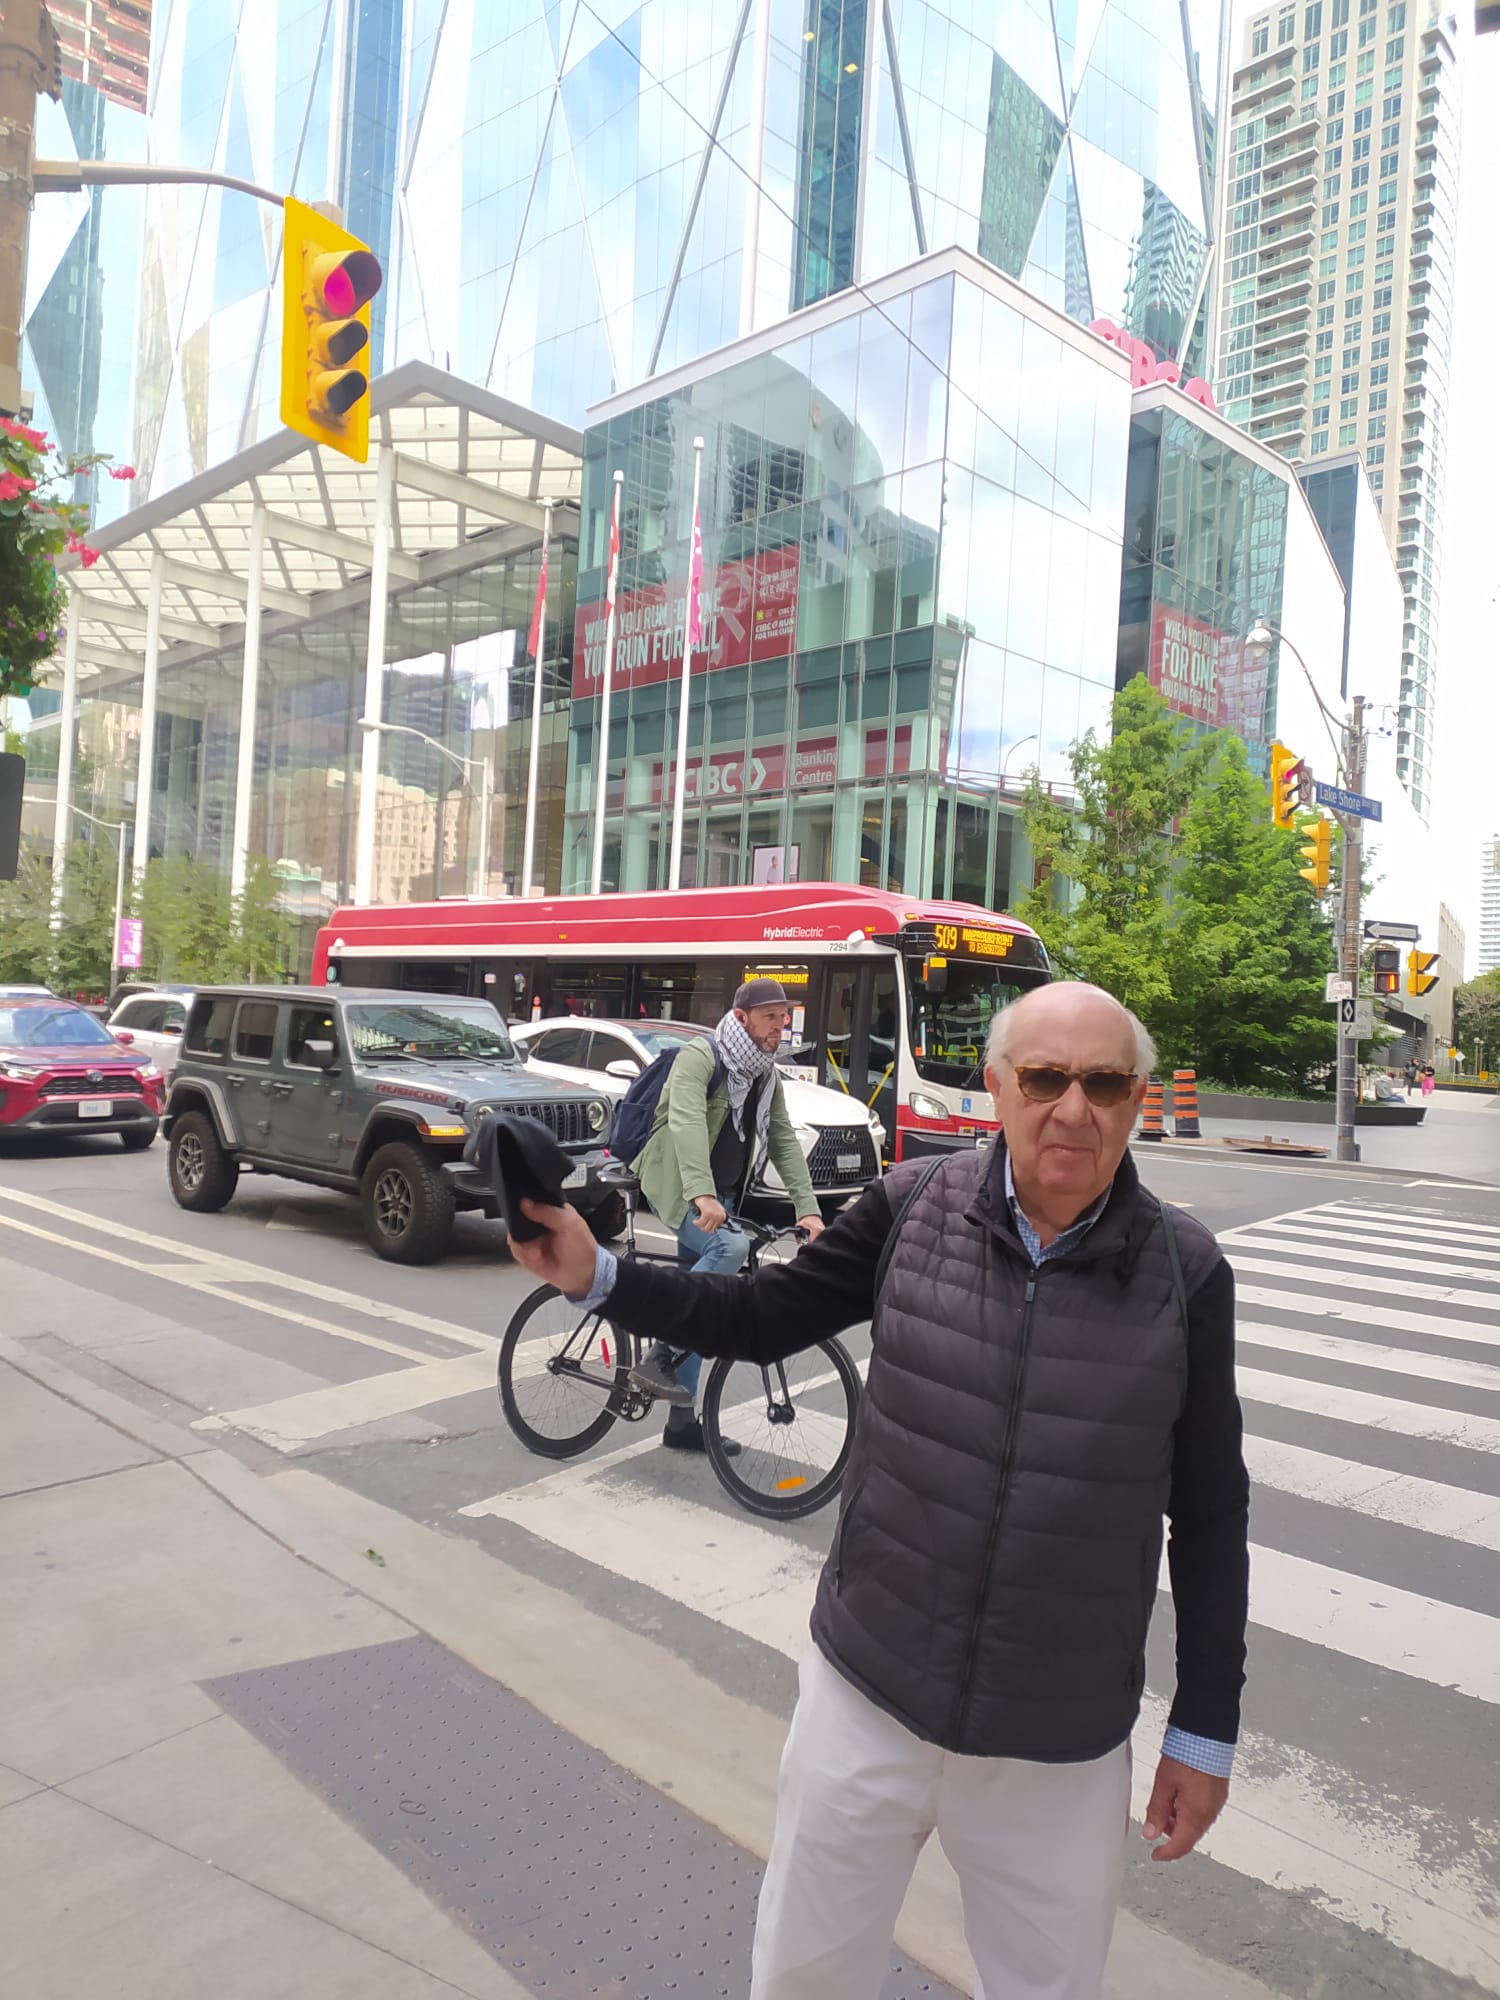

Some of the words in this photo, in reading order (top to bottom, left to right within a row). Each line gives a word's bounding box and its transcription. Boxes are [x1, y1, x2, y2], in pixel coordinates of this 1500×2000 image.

[644, 603, 668, 630] RUN
[755, 622, 771, 633] CIBC
[779, 617, 794, 627] RUN
[755, 631, 766, 641] FOR
[767, 628, 778, 638] THE
[1164, 616, 1187, 644] WHEN
[1188, 628, 1202, 650] YOU
[616, 632, 649, 672] RUN
[652, 624, 685, 664] FOR
[1161, 639, 1189, 683] FOR
[1191, 651, 1217, 694] ONE
[1160, 677, 1174, 697] YOU
[1174, 682, 1189, 704] RUN
[1189, 687, 1202, 707] FOR
[682, 762, 737, 798] CIBC
[795, 769, 833, 785] Centre
[1320, 784, 1337, 803] Lake
[1338, 791, 1360, 810] Shore
[763, 926, 824, 940] HybridElectric
[935, 924, 958, 950] 509
[829, 943, 848, 952] 7294
[375, 1083, 449, 1103] RUBICON
